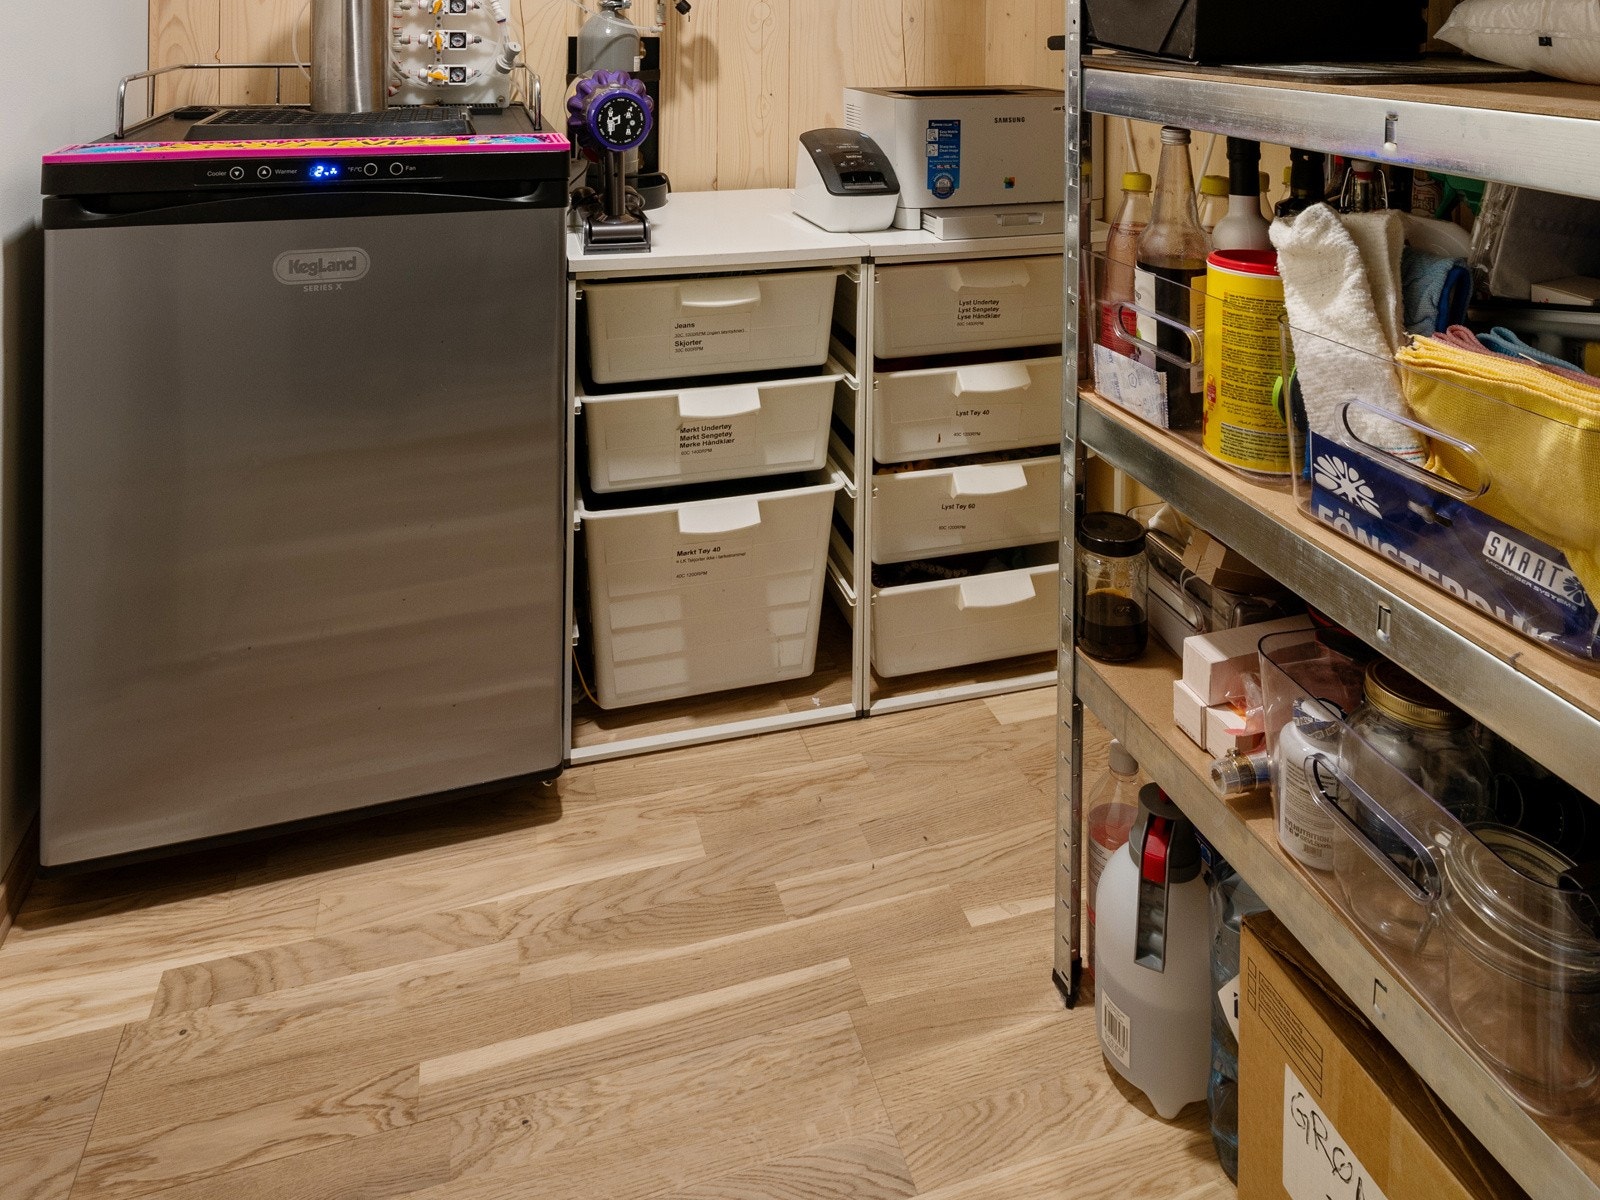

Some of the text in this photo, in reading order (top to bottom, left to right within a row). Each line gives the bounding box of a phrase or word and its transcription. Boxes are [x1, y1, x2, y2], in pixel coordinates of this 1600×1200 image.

[994, 116, 1026, 124] SAMSUNG
[288, 256, 357, 277] KegLand
[303, 283, 333, 293] SERIES
[674, 339, 702, 348] Skjorter
[701, 423, 732, 432] Undertøy
[680, 431, 733, 441] Mørkt Sengetøy
[702, 438, 735, 446] Håndklær
[677, 549, 697, 557] Mørkt
[1488, 536, 1564, 588] SMART
[1485, 558, 1532, 588] MICROFIBER
